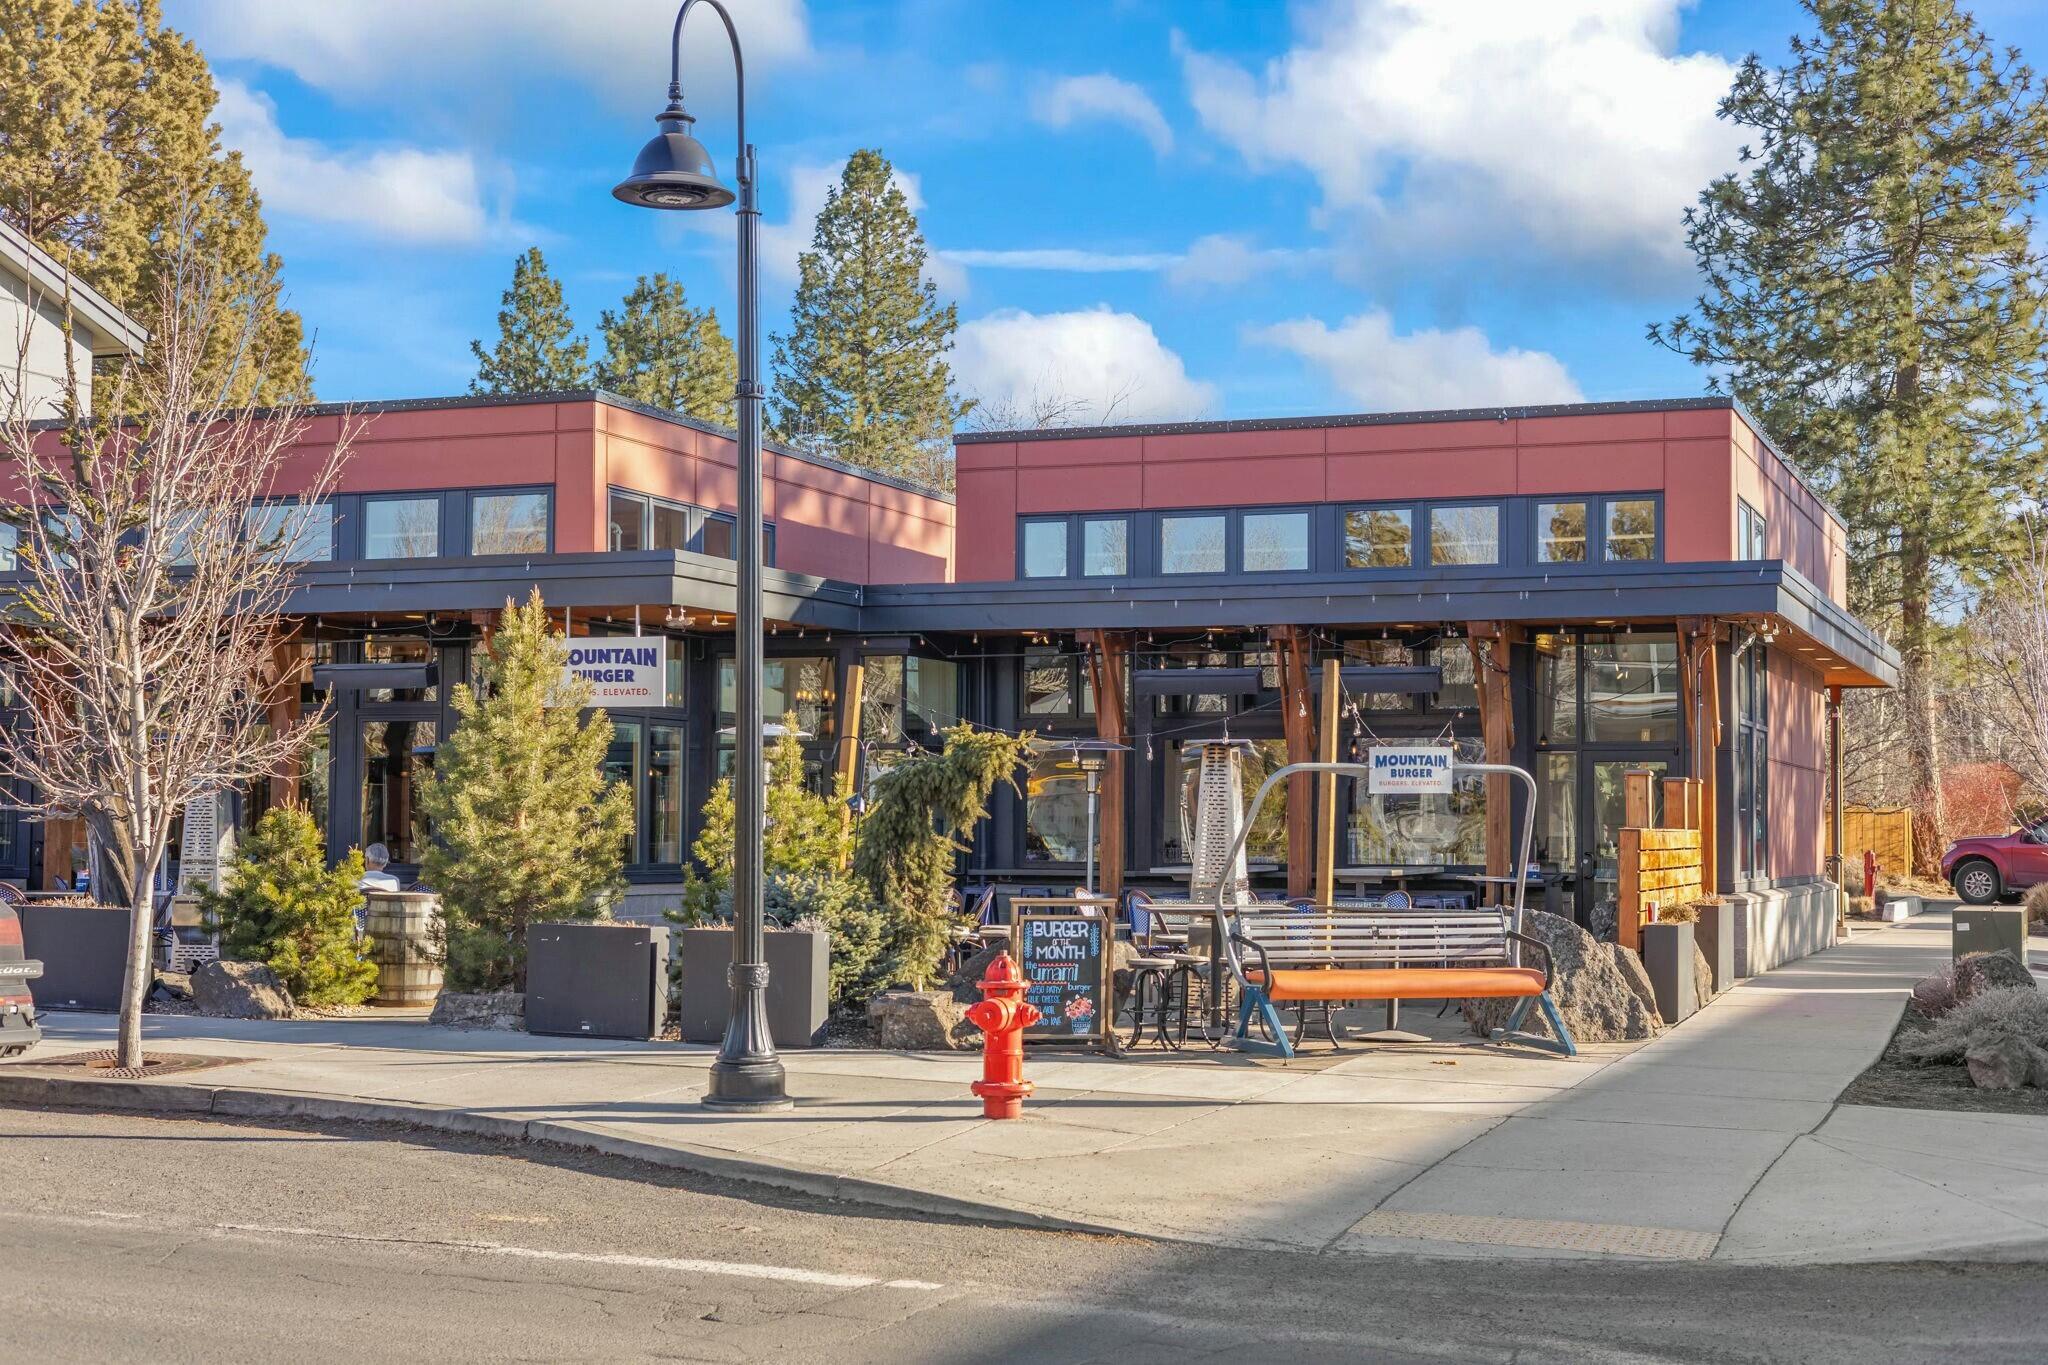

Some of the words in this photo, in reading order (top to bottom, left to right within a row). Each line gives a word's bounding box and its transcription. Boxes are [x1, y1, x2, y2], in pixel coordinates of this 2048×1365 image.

[563, 648, 657, 667] OUNTAIN
[603, 688, 651, 696] ELEVATED.
[1375, 755, 1447, 768] MOUNTAIN
[1391, 769, 1432, 777] BURGER
[1033, 921, 1089, 938] BURGER
[1036, 945, 1085, 960] MONTH
[1067, 982, 1092, 994] burger
